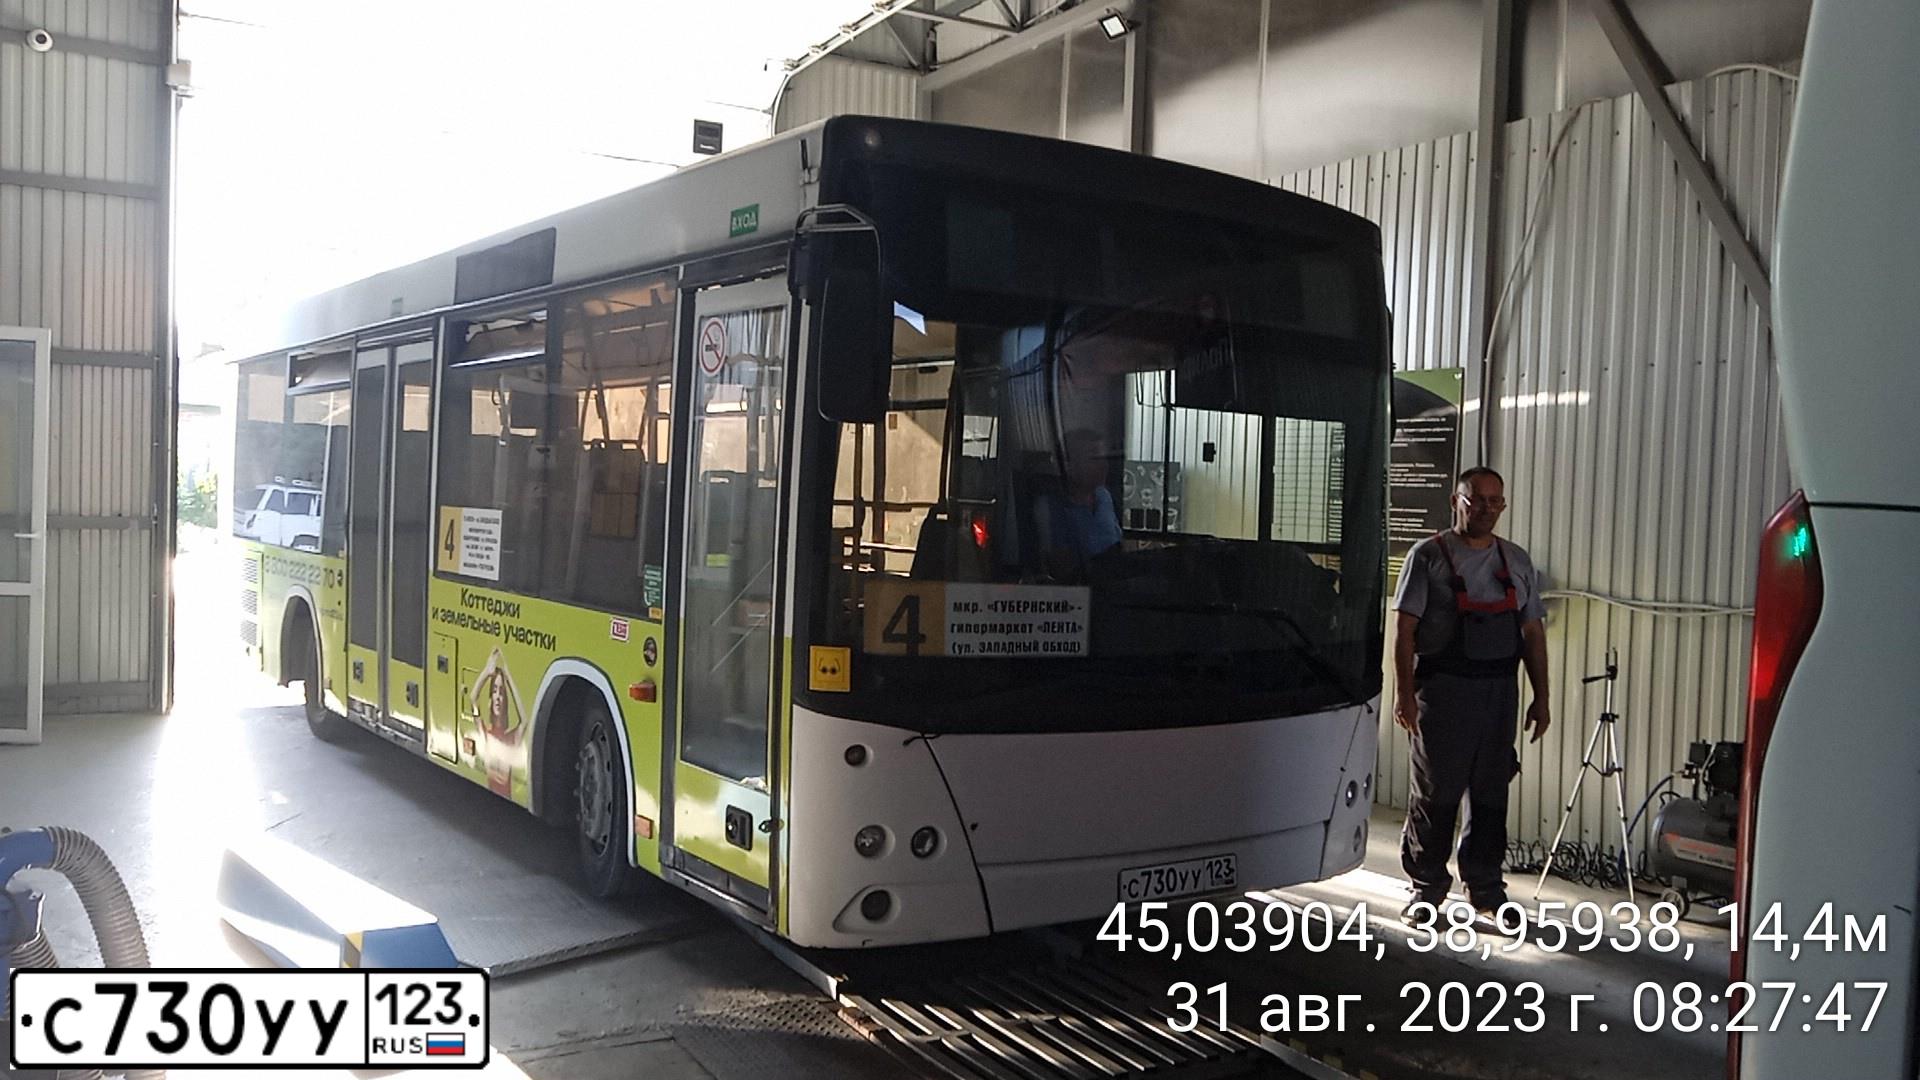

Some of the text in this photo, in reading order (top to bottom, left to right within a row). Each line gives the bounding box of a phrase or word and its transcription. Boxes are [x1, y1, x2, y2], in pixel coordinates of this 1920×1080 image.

[444, 518, 455, 561] 4
[460, 587, 521, 619] Коттеджи
[953, 601, 983, 614] мкр.
[432, 606, 556, 652] и земельные участки
[882, 594, 927, 656] 4
[950, 621, 1083, 636] гипермаркет «ЛЕНТА»
[952, 640, 1081, 655] (ул. ЗАПАДНЫЙ ОБХОД)
[1206, 858, 1233, 880] 123
